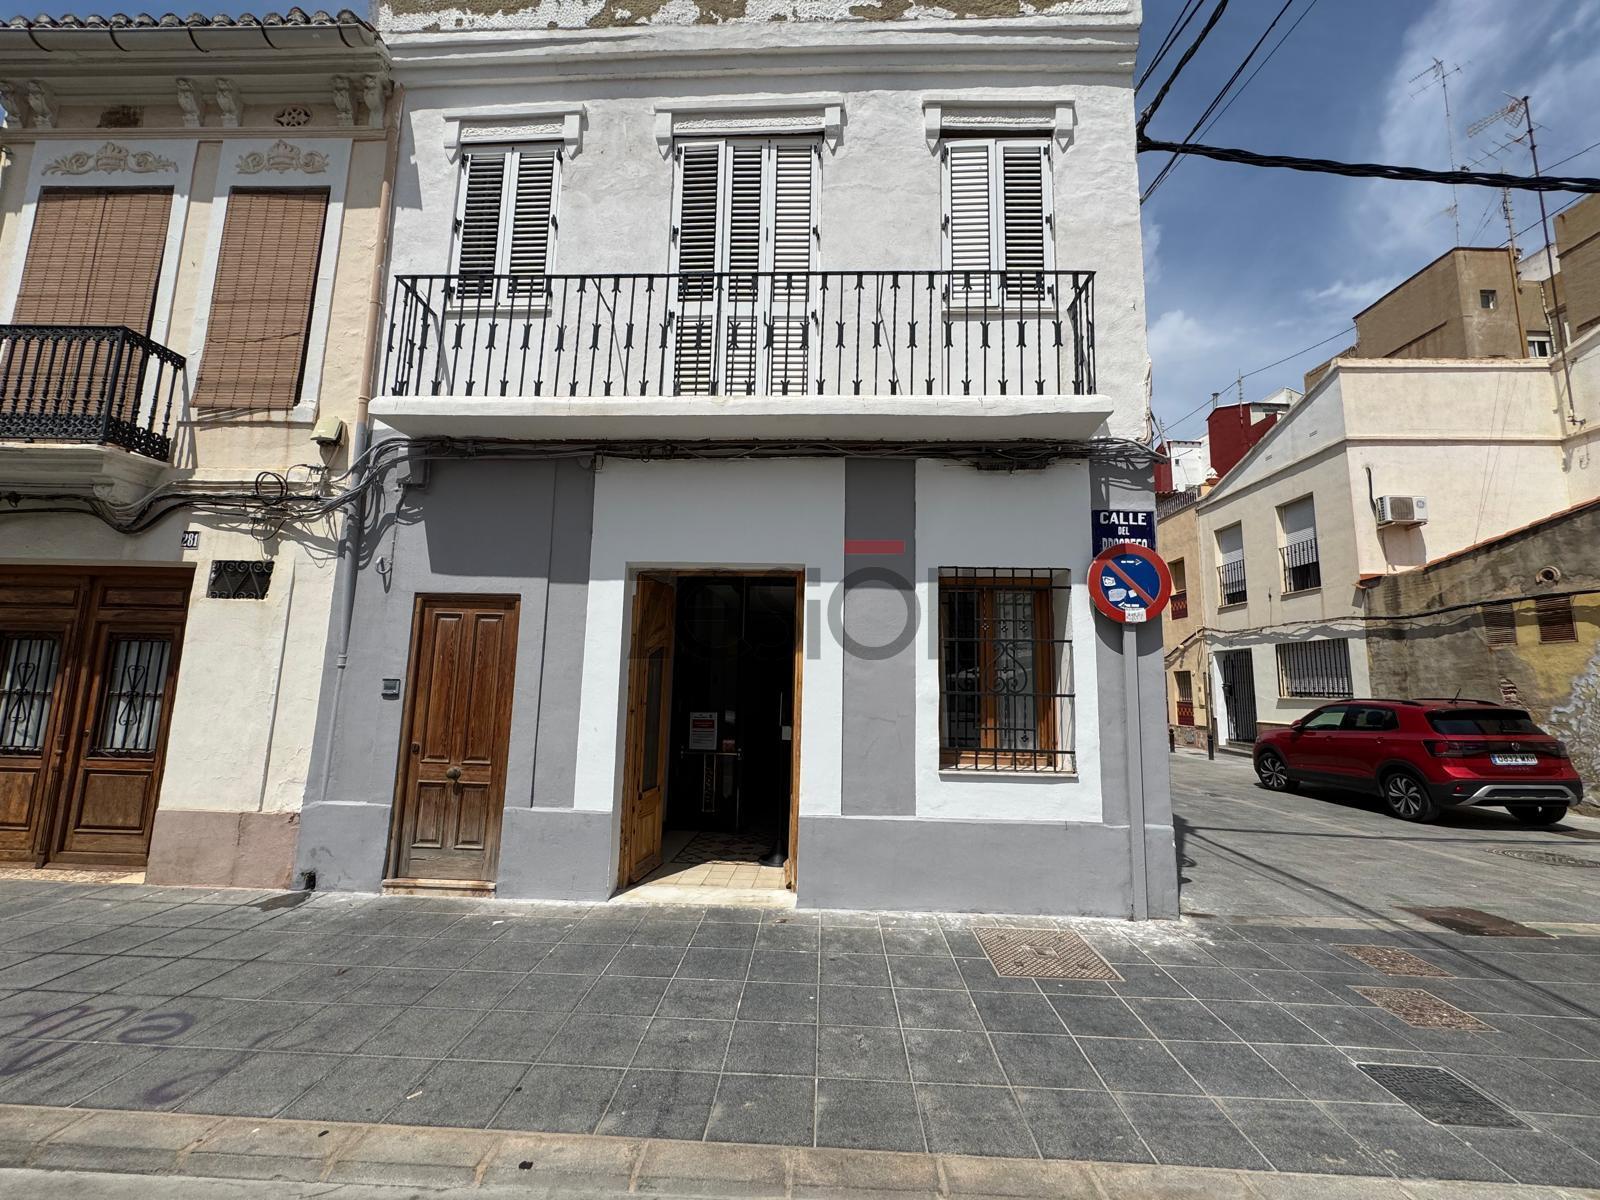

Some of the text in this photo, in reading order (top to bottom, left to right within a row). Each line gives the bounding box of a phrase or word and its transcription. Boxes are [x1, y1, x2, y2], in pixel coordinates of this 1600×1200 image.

[1100, 511, 1147, 525] CALLE
[1117, 526, 1130, 536] DEL
[182, 533, 198, 546] 281
